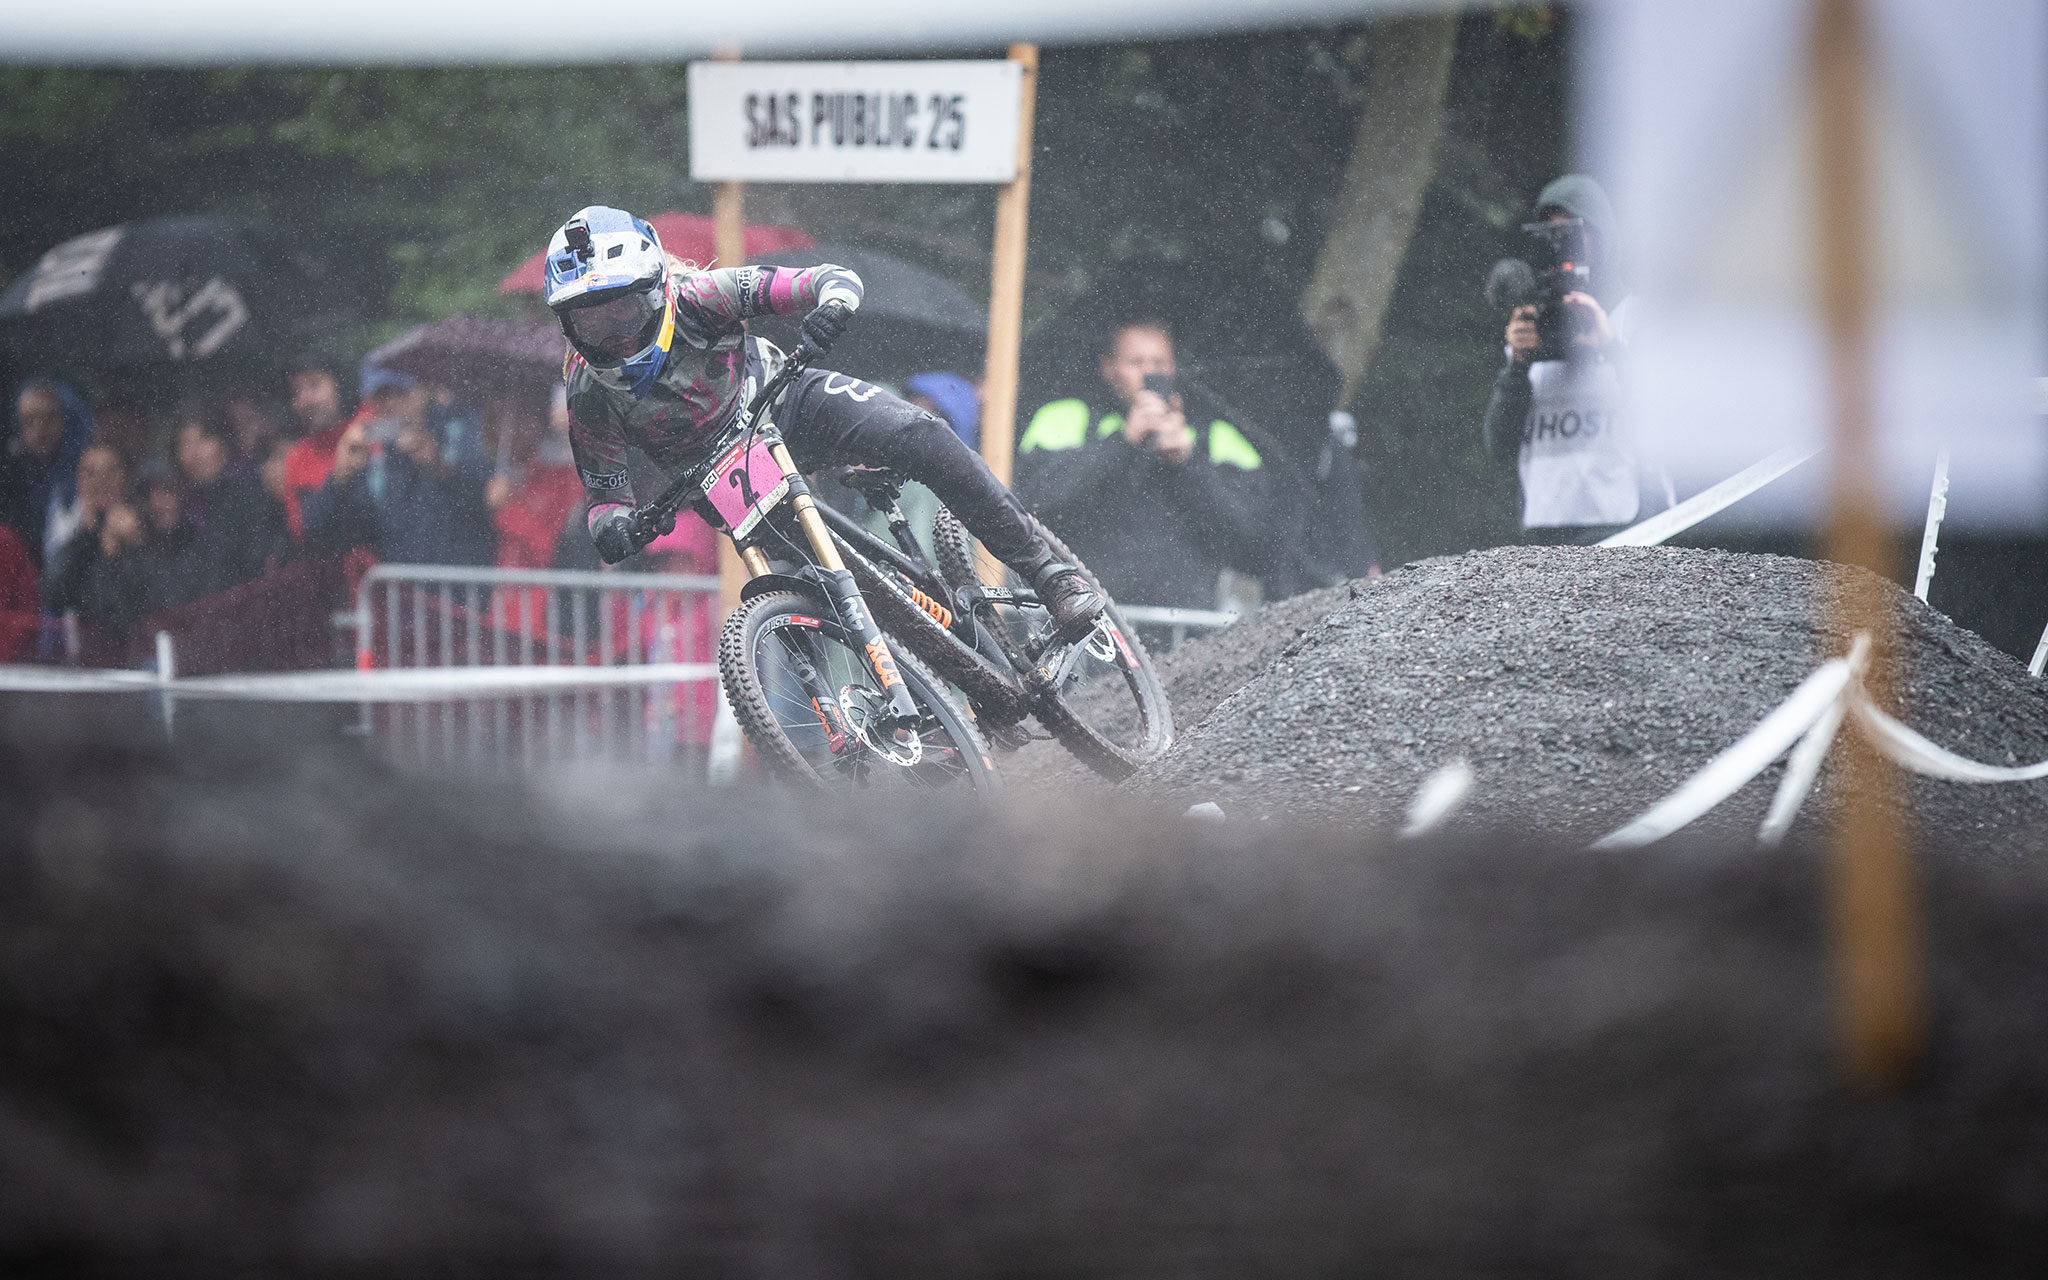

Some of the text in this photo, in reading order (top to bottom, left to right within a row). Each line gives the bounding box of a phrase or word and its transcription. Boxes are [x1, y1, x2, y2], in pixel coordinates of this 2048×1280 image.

[745, 92, 965, 149] SAS PUBLIC 25
[702, 472, 718, 491] UCI
[729, 468, 761, 509] 2
[865, 640, 906, 690] FOX
